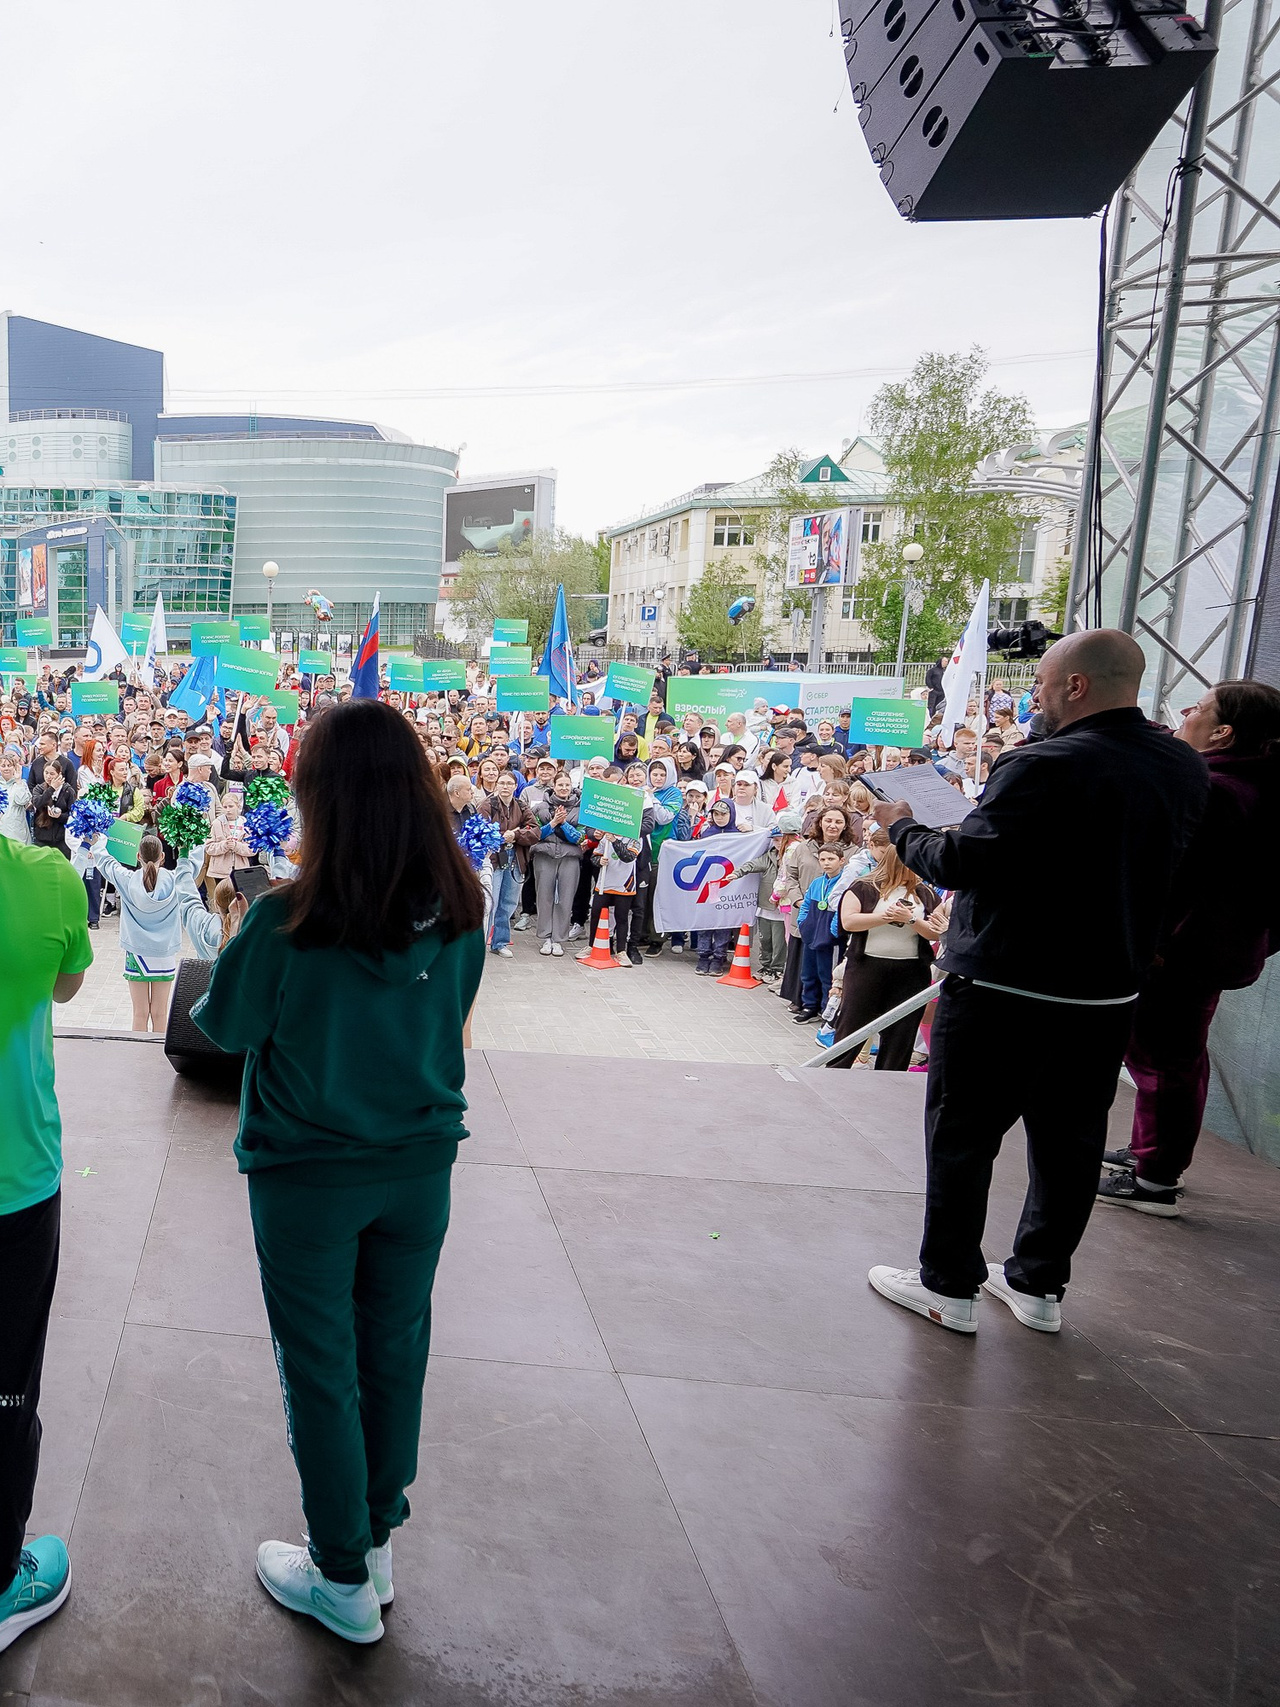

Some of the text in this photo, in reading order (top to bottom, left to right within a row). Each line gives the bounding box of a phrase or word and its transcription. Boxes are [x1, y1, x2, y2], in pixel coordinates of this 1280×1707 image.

[645, 608, 654, 620] P
[221, 662, 259, 674] ПРИРОДНАДЗОР
[675, 703, 726, 715] ВЗРОСЛЫЙ
[719, 891, 759, 903] ОЦИАЛЬ
[715, 901, 745, 910] ФОНД
